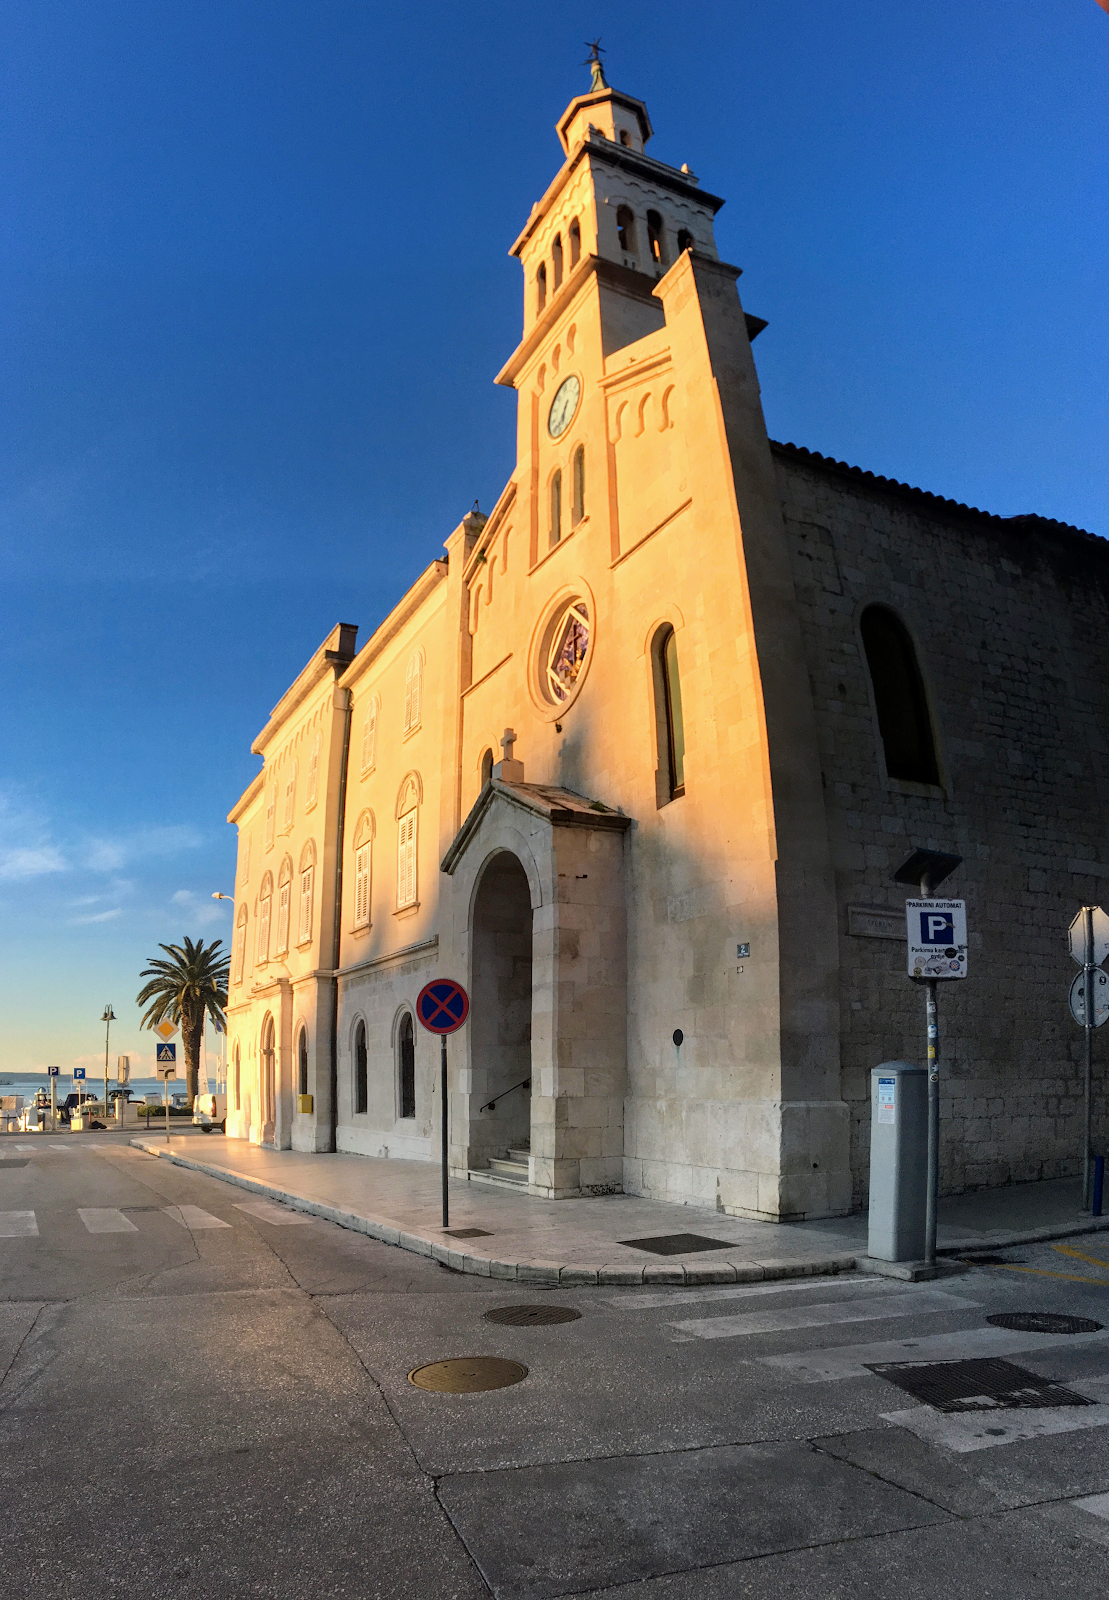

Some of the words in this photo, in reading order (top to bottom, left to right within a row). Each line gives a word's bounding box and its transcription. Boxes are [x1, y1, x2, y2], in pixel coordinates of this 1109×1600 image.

[928, 916, 947, 940] P
[740, 944, 746, 954] 2
[76, 1070, 82, 1078] P
